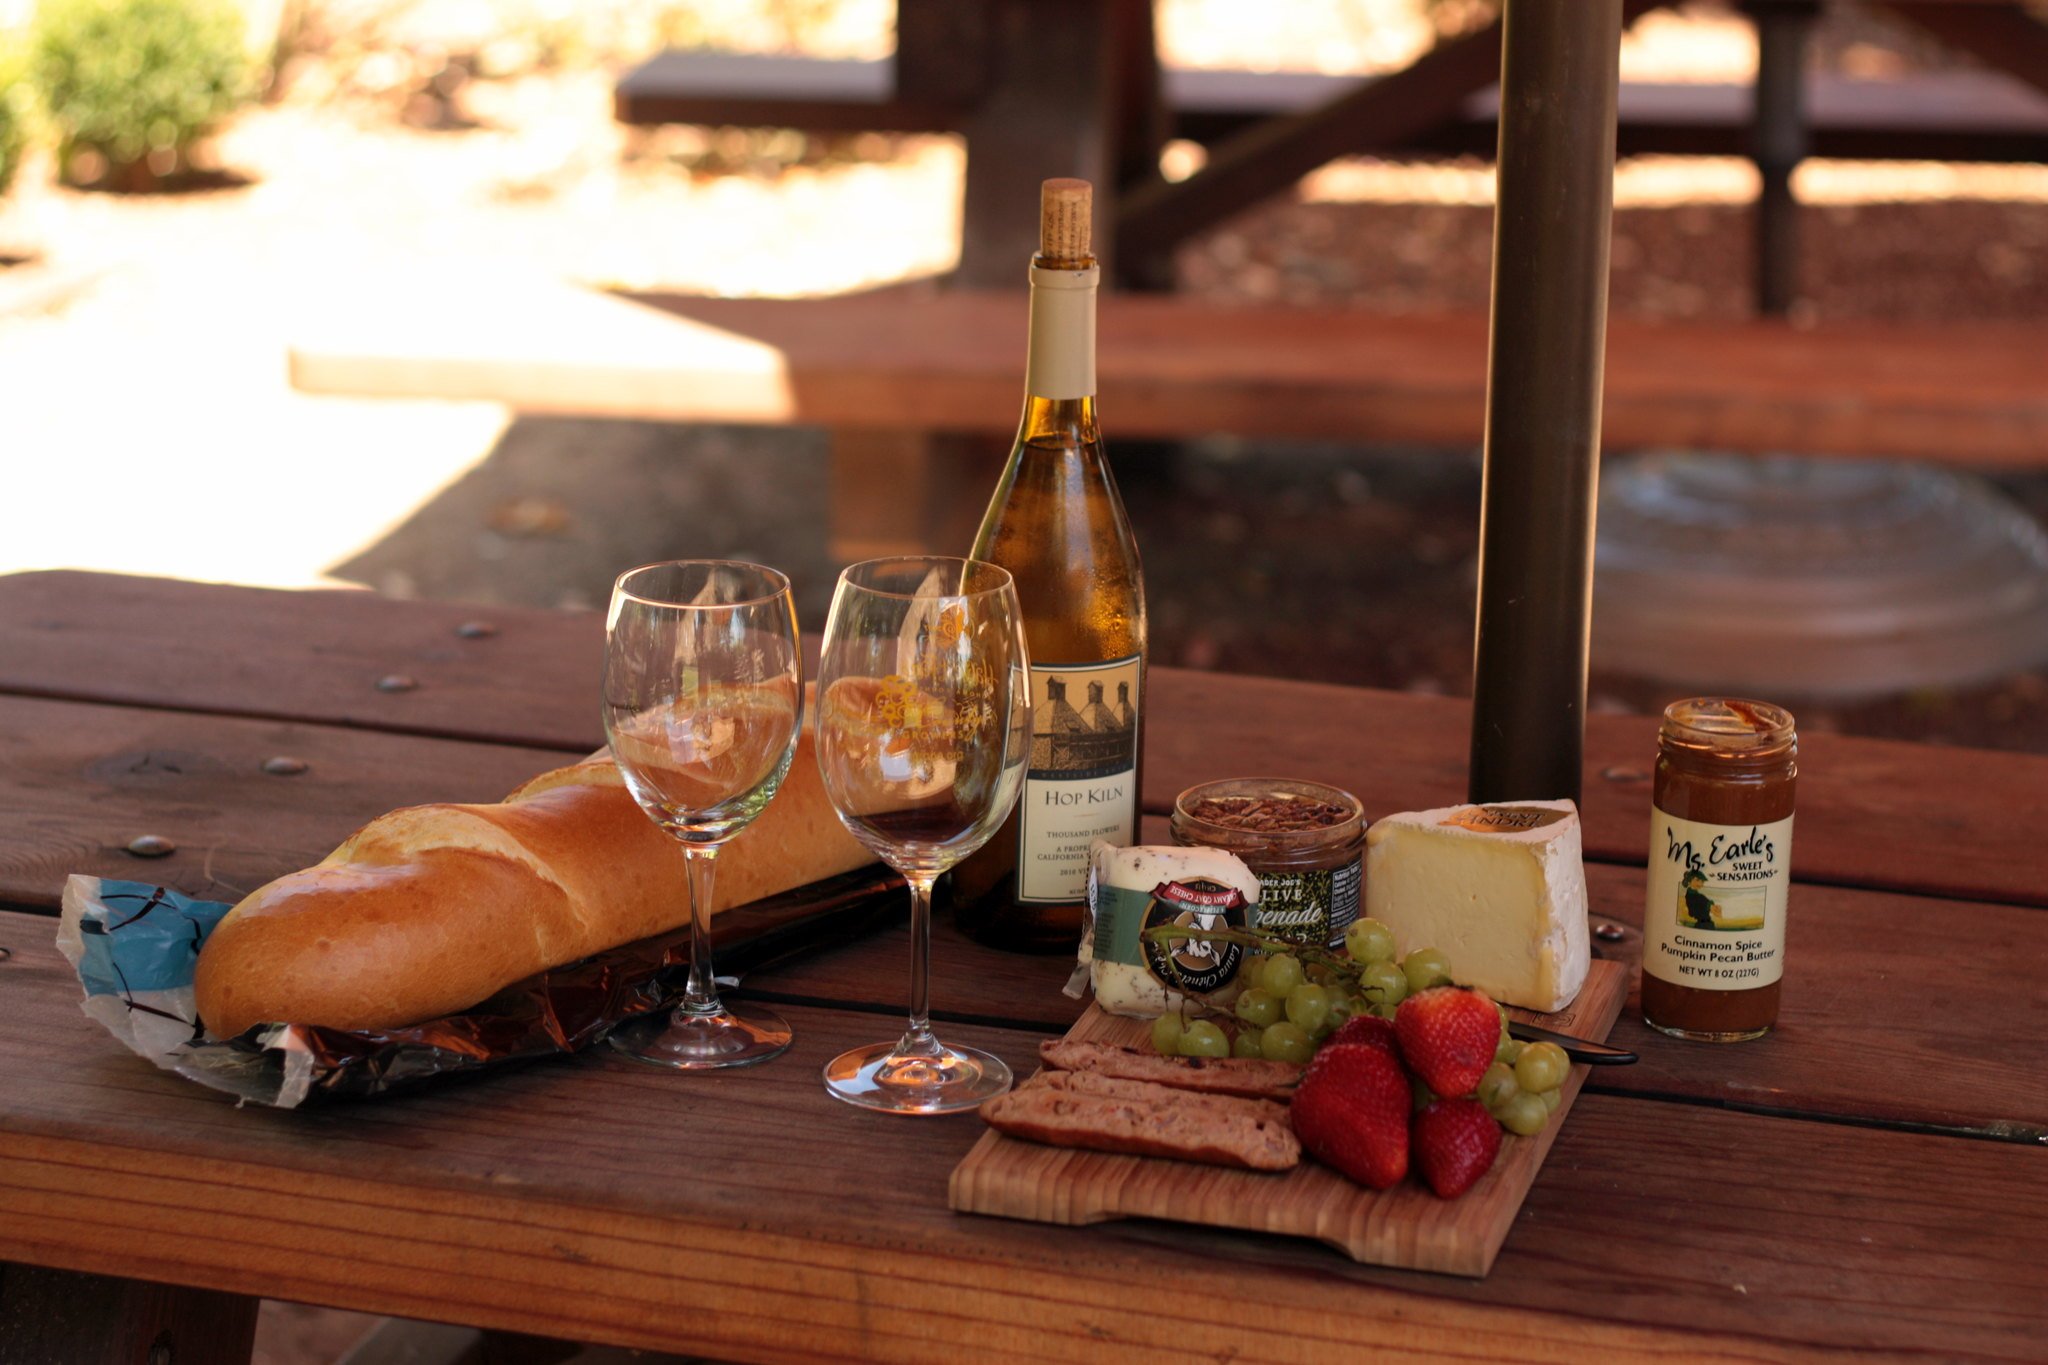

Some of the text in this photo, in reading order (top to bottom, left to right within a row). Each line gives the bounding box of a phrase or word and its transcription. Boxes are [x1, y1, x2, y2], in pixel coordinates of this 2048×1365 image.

[1046, 786, 1123, 806] HOP KILN
[1047, 825, 1119, 839] THOUSAND FLOWERS
[1667, 825, 1774, 871] Ms. Earle's
[1037, 853, 1084, 861] CALIFORNIA
[1732, 861, 1763, 871] SWEET
[1717, 869, 1774, 881] SENSATIONS
[1170, 885, 1194, 900] CHEESE
[1261, 889, 1303, 902] LIVE
[1255, 901, 1322, 926] penade
[1674, 935, 1762, 952] Cinnamon Spice
[1661, 942, 1775, 962] Pumpkin Pecan Butter
[1218, 944, 1240, 978] Laura
[1679, 965, 1760, 980] NET WT 8 OZ (227G)
